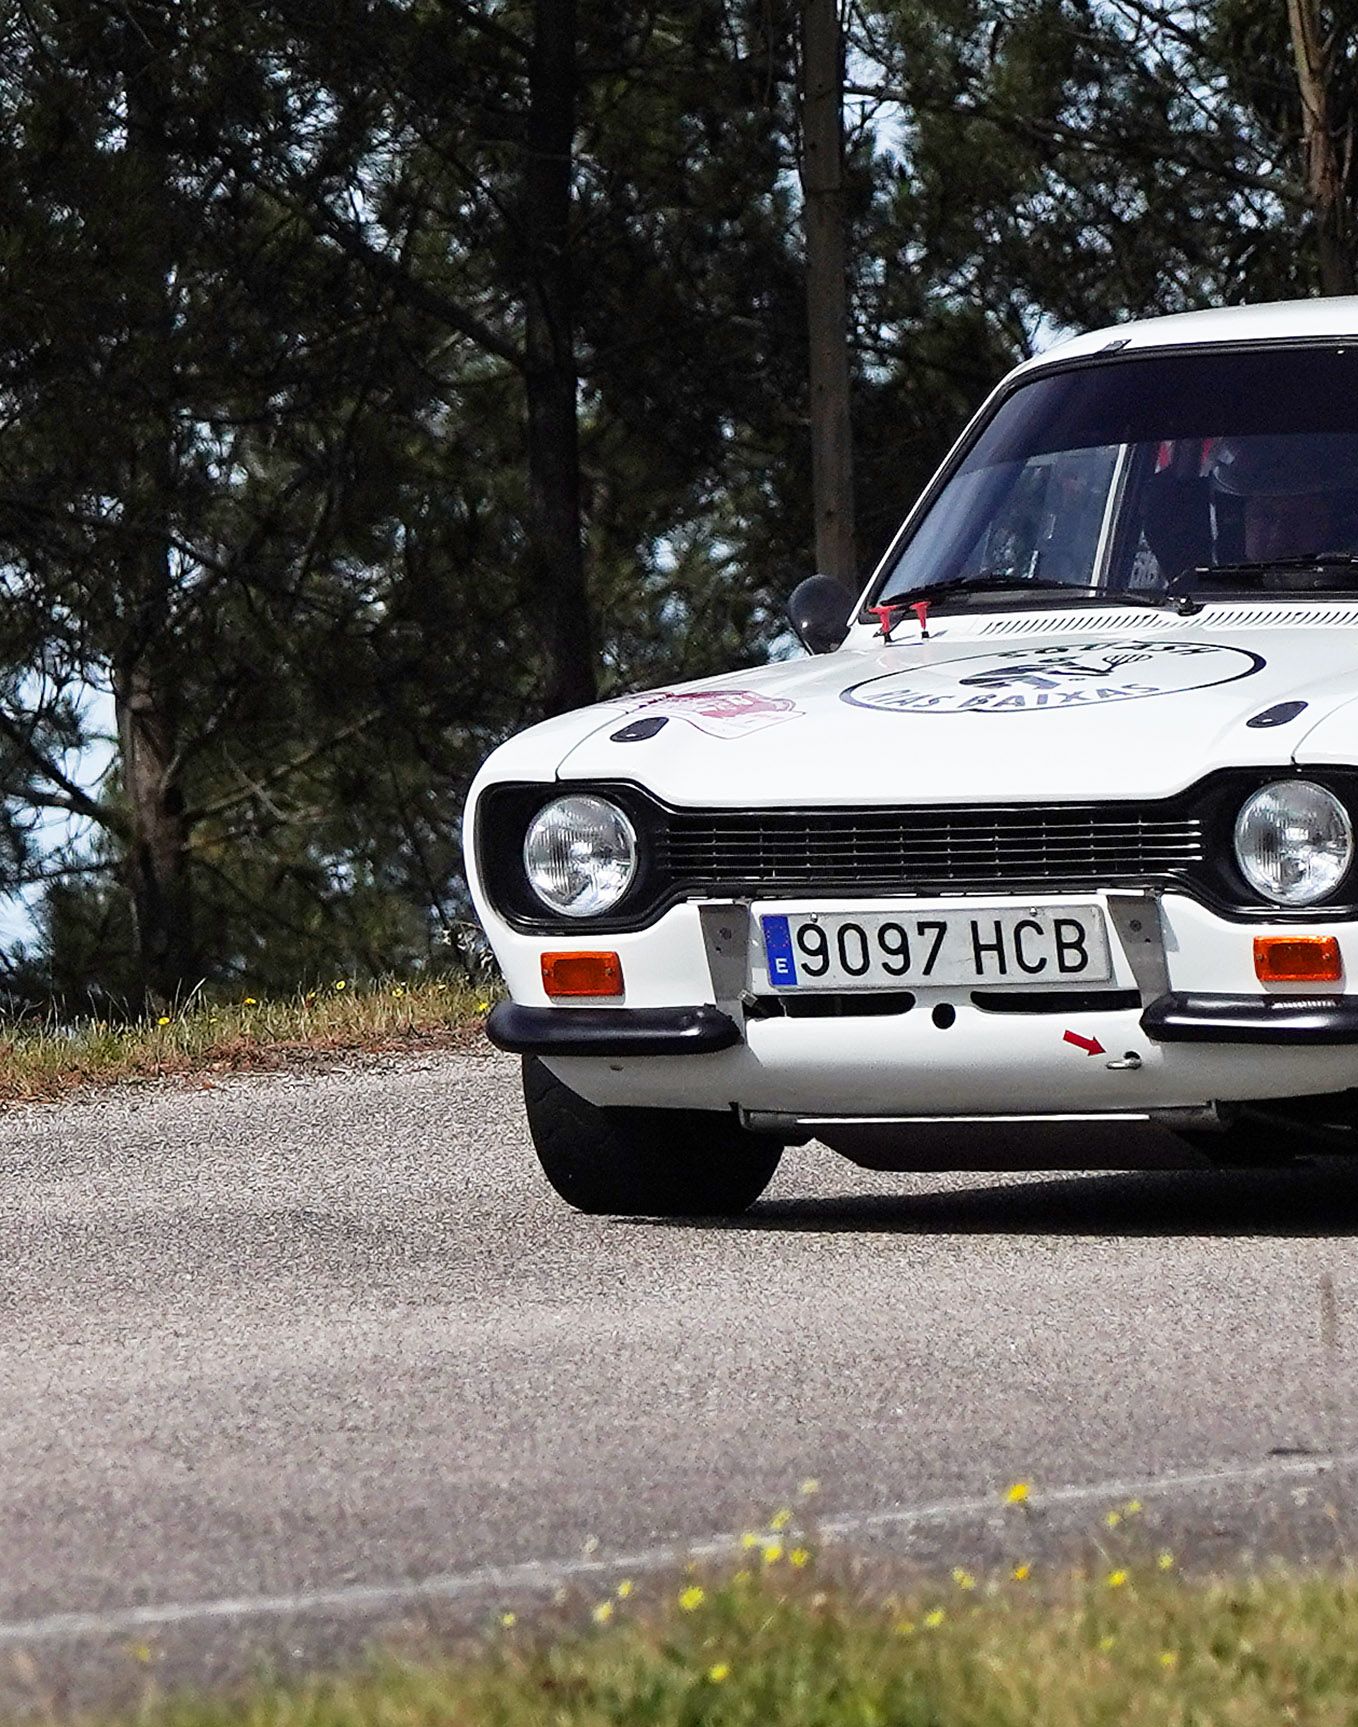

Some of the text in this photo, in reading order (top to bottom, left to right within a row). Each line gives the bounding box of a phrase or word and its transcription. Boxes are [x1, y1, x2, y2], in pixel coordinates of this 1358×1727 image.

[956, 683, 1160, 709] BAIXAS
[796, 918, 1089, 977] 9097 HCB
[775, 957, 789, 974] E
